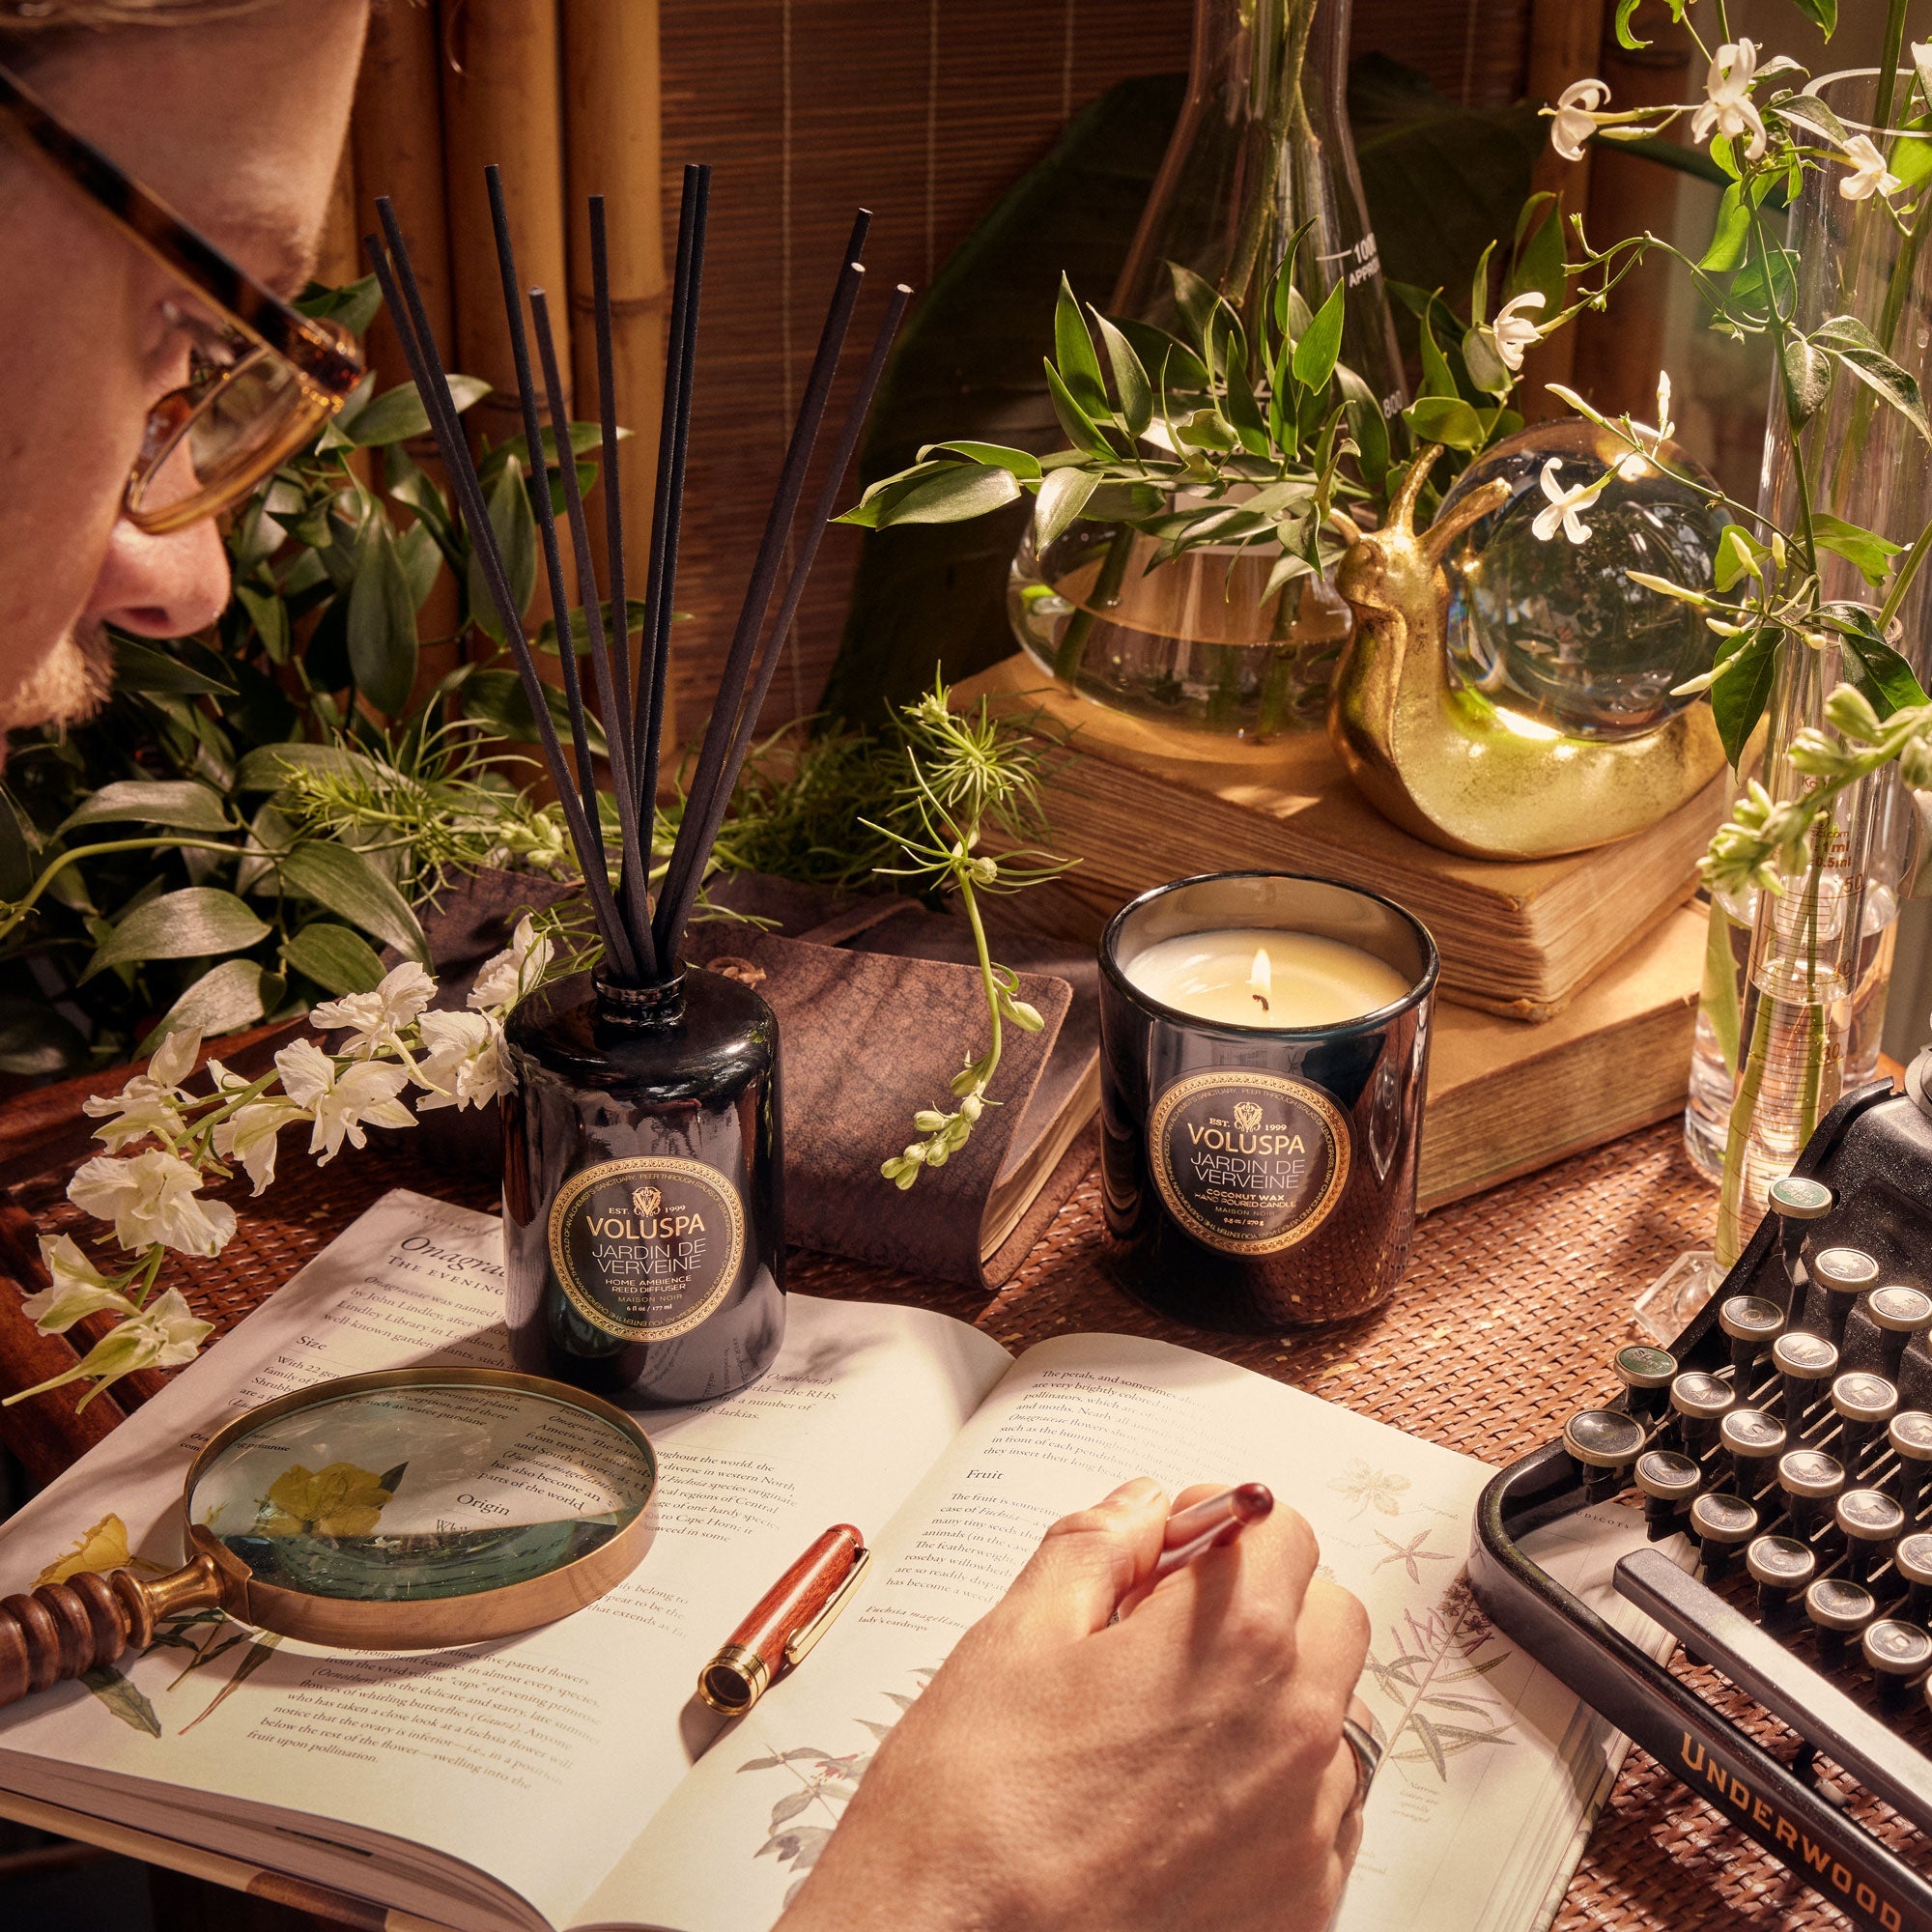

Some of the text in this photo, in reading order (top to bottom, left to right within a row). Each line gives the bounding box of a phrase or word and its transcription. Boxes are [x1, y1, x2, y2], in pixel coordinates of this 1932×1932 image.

[1209, 1118, 1230, 1127] EST.
[1187, 1123, 1305, 1154] VOLUSPA
[1191, 1151, 1305, 1174] JARDIN DE
[1195, 1166, 1299, 1188] VERVEINE
[1207, 1189, 1256, 1201] COCONUT
[1221, 1199, 1258, 1208] POURED
[1215, 1207, 1249, 1215] MAISON
[586, 1213, 705, 1239] VOLUSPA
[592, 1238, 706, 1261] JARDIN DE
[597, 1257, 701, 1274] VERVEINE
[386, 1255, 504, 1296] THE EVENING
[639, 1275, 692, 1286] AMBIENCE
[640, 1284, 686, 1293] DIFFUSER
[351, 1288, 475, 1328] by John Lindley, after
[432, 1295, 452, 1306] was
[454, 1302, 494, 1320] named
[337, 1299, 496, 1351] Lindley Library in London,
[296, 1335, 327, 1350] Size
[324, 1314, 504, 1368] well-known garden plants, such
[276, 1355, 321, 1377] With 22
[263, 1366, 297, 1385] family
[1042, 1370, 1094, 1381] The petals,
[806, 1389, 840, 1401] RHS
[1023, 1392, 1083, 1402] pollinators,
[1050, 1381, 1118, 1397] very brightly
[455, 1404, 509, 1420] and there
[485, 1399, 521, 1413] plants.
[685, 1404, 760, 1420] and clarkias.
[748, 1399, 797, 1408] number
[440, 1412, 487, 1427] purslane
[536, 1423, 612, 1450] America. The
[514, 1441, 536, 1453] and
[538, 1447, 573, 1463] South
[526, 1432, 626, 1467] from tropical and
[491, 1460, 601, 1501] has also become an
[664, 1462, 796, 1492] diverse western North
[966, 1469, 1004, 1480] Fruit
[477, 1471, 510, 1486] parts
[526, 1484, 545, 1497] the
[710, 1481, 747, 1493] species
[456, 1493, 510, 1517] Origin
[679, 1491, 779, 1515] regions Central
[709, 1504, 742, 1519] hardy
[675, 1515, 705, 1526] Cape
[931, 1517, 960, 1525] many
[1576, 1511, 1631, 1529] UDICOTS
[701, 1531, 730, 1542] some
[922, 1528, 966, 1539] animals
[904, 1553, 948, 1564] rosebay
[325, 1655, 409, 1676] from vivid
[482, 1668, 522, 1684] almost
[299, 1679, 469, 1718] flowers whirling butterflies
[420, 1685, 467, 1701] delicate
[288, 1692, 369, 1715] who taken
[260, 1717, 296, 1730] below
[273, 1705, 393, 1735] notice ovary
[247, 1730, 379, 1763] fruit upon pollination.
[1680, 1731, 1904, 1932] UNDERWOOD
